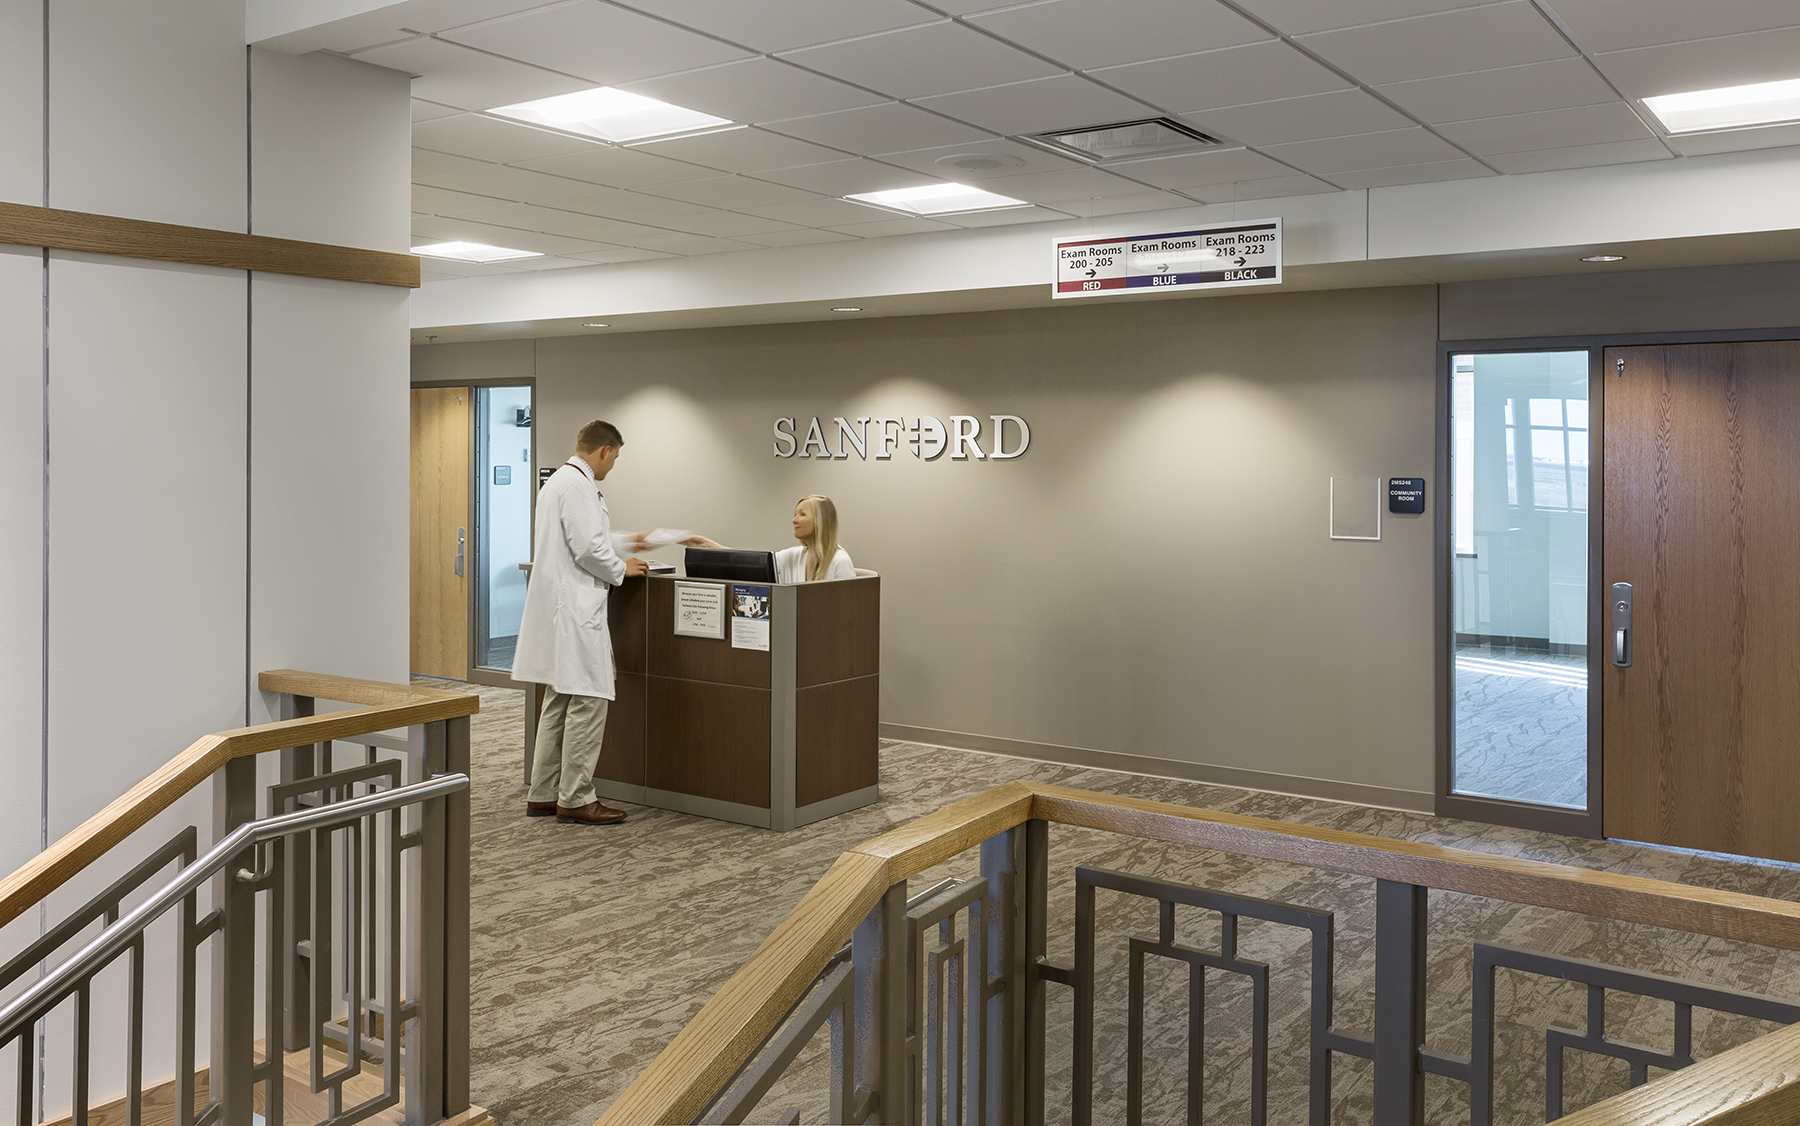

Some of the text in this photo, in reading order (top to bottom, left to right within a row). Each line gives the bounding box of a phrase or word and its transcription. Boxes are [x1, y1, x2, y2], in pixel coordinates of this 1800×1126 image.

[1206, 232, 1276, 247] Exam Rooms
[1061, 246, 1122, 259] Exam Rooms
[1131, 240, 1197, 253] Exam Rooms
[1216, 247, 1236, 257] 218
[1245, 245, 1265, 255] 223
[1069, 259, 1087, 269] 200
[1095, 257, 1113, 268] 205
[1153, 275, 1177, 286] BLUE
[1224, 269, 1258, 281] BLACK
[1083, 281, 1101, 291] RED
[773, 415, 1032, 461] SANFORD
